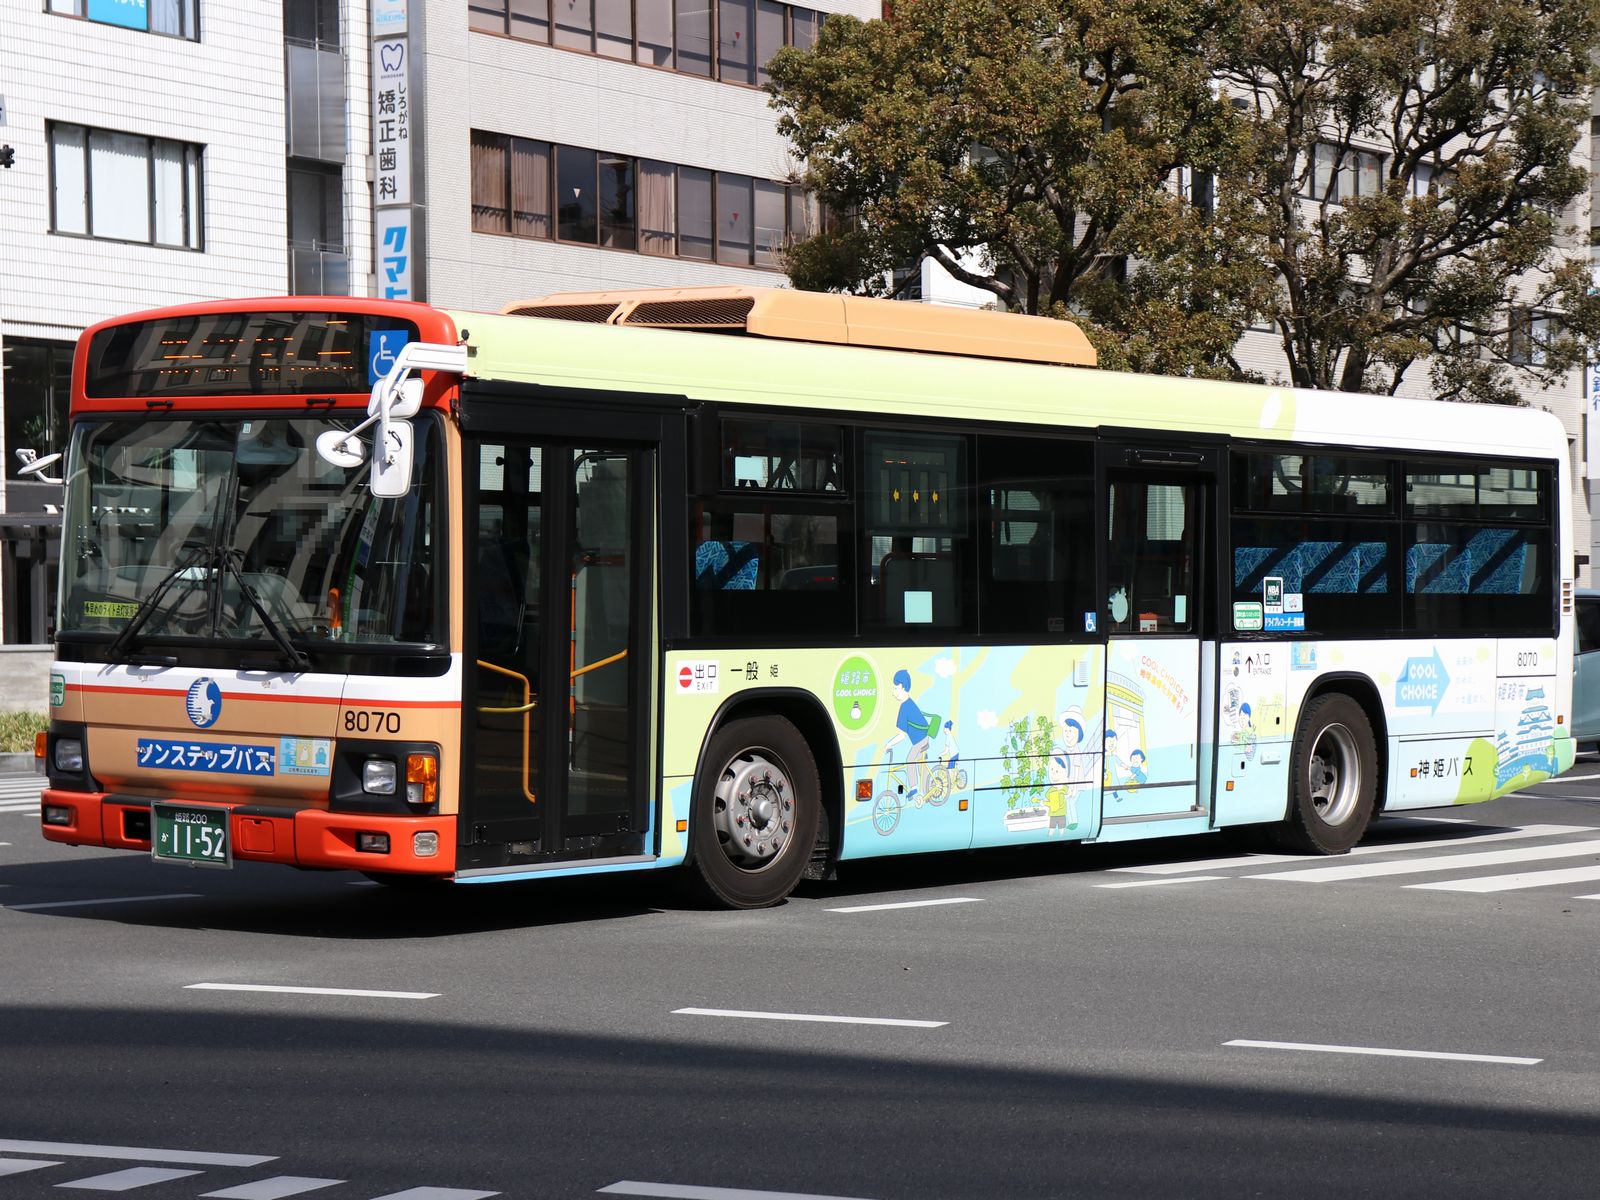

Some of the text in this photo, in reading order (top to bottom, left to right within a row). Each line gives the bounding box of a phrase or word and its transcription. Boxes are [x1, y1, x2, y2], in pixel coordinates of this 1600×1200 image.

[398, 81, 408, 139] しろがね
[378, 89, 397, 200] 矯正歯科
[1267, 586, 1279, 596] NBA
[1141, 655, 1160, 673] COOL
[1255, 653, 1271, 665] 入口
[1517, 652, 1537, 667] 8070
[695, 663, 717, 679] 出口
[730, 661, 759, 681] 一般
[1409, 664, 1438, 679] COOL
[696, 681, 714, 690] EXIT
[835, 688, 877, 697] COOL CHOICE
[1401, 684, 1438, 700] CHOICE
[345, 711, 401, 733] 8070
[138, 743, 272, 772] ノンステップバス
[1418, 757, 1474, 779] 神姫バス
[161, 824, 225, 858] か 11-52
